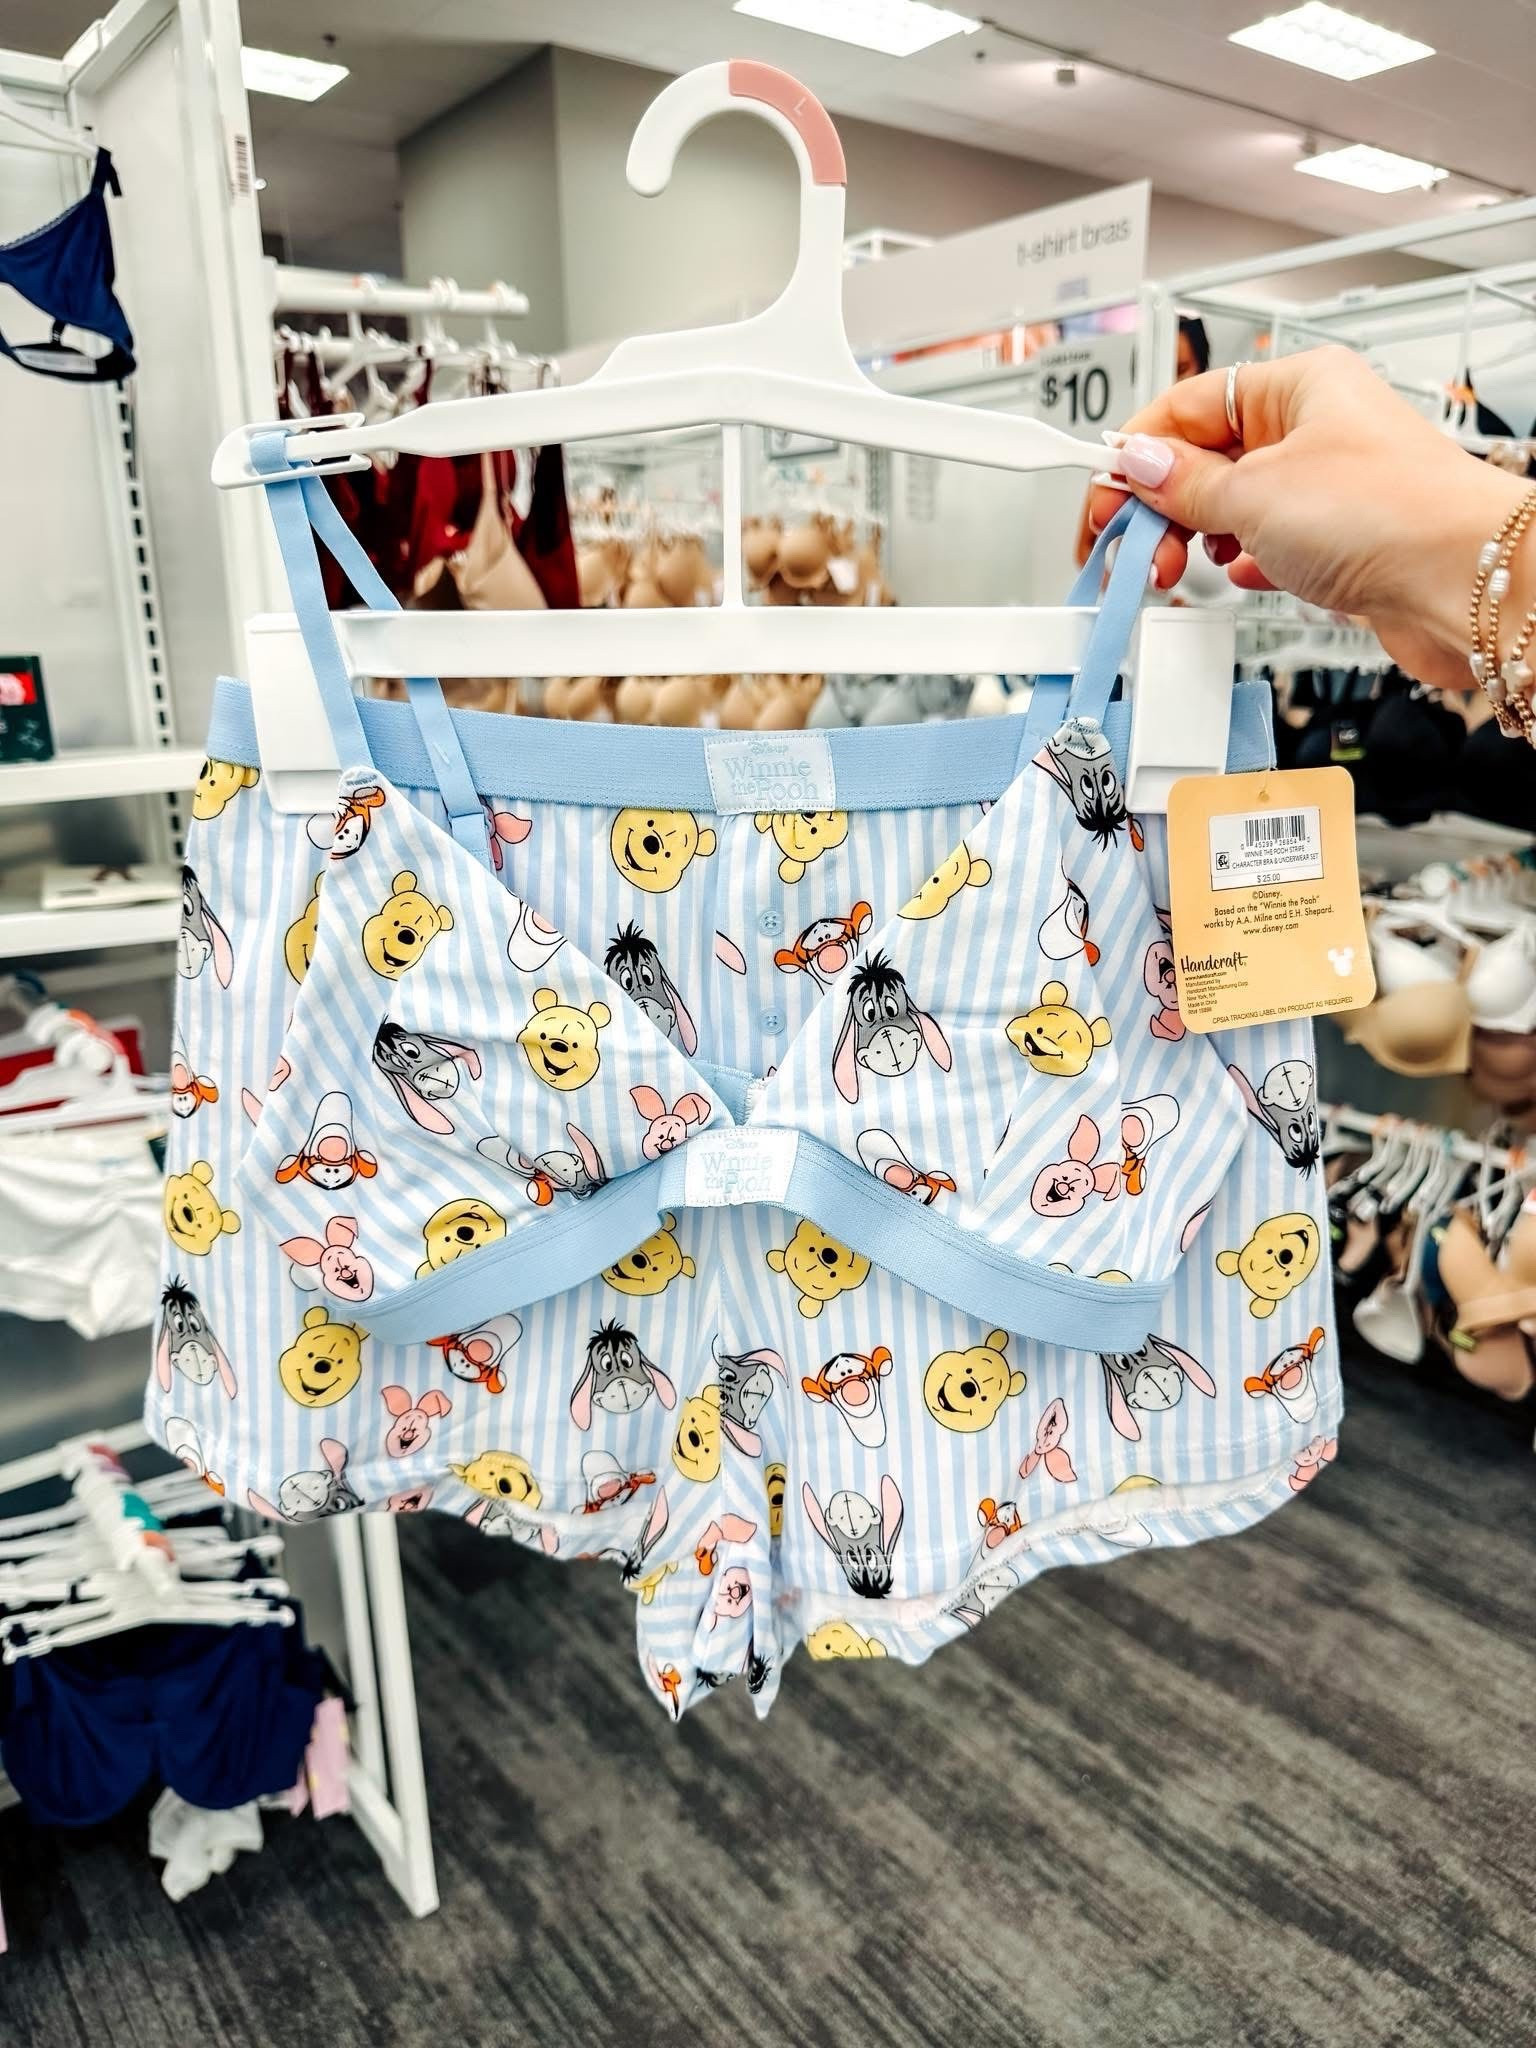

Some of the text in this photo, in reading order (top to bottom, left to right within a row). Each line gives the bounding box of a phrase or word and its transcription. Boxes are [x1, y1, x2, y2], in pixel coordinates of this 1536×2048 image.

[1016, 219, 1131, 267] t-shirt bras
[1042, 367, 1109, 425] $10
[722, 757, 812, 779] Winnie
[753, 776, 819, 801] Pooh
[1232, 859, 1262, 869] CHARACTER
[1263, 858, 1273, 866] BRA
[1279, 854, 1309, 864] UNDERWEAR
[1244, 845, 1305, 858] WINNIE THE POOH STRIPE
[1203, 904, 1334, 929] works by A.A. Milne and E.H. Shepard.
[1214, 905, 1235, 916] Based
[1247, 903, 1258, 912] the
[1288, 898, 1299, 907] the
[1243, 922, 1299, 935] www.disney.com
[1185, 971, 1227, 981] www.handcraft.com
[1185, 979, 1215, 988] Manufactured
[1186, 986, 1207, 995] Handcraft
[1207, 983, 1238, 992] Manufacturing
[1212, 996, 1353, 1024] CPSIA TRACKING LABEL ON PRODUCT AS REQUIRED
[700, 1151, 773, 1173] Winnie
[723, 1171, 772, 1193] Pooh
